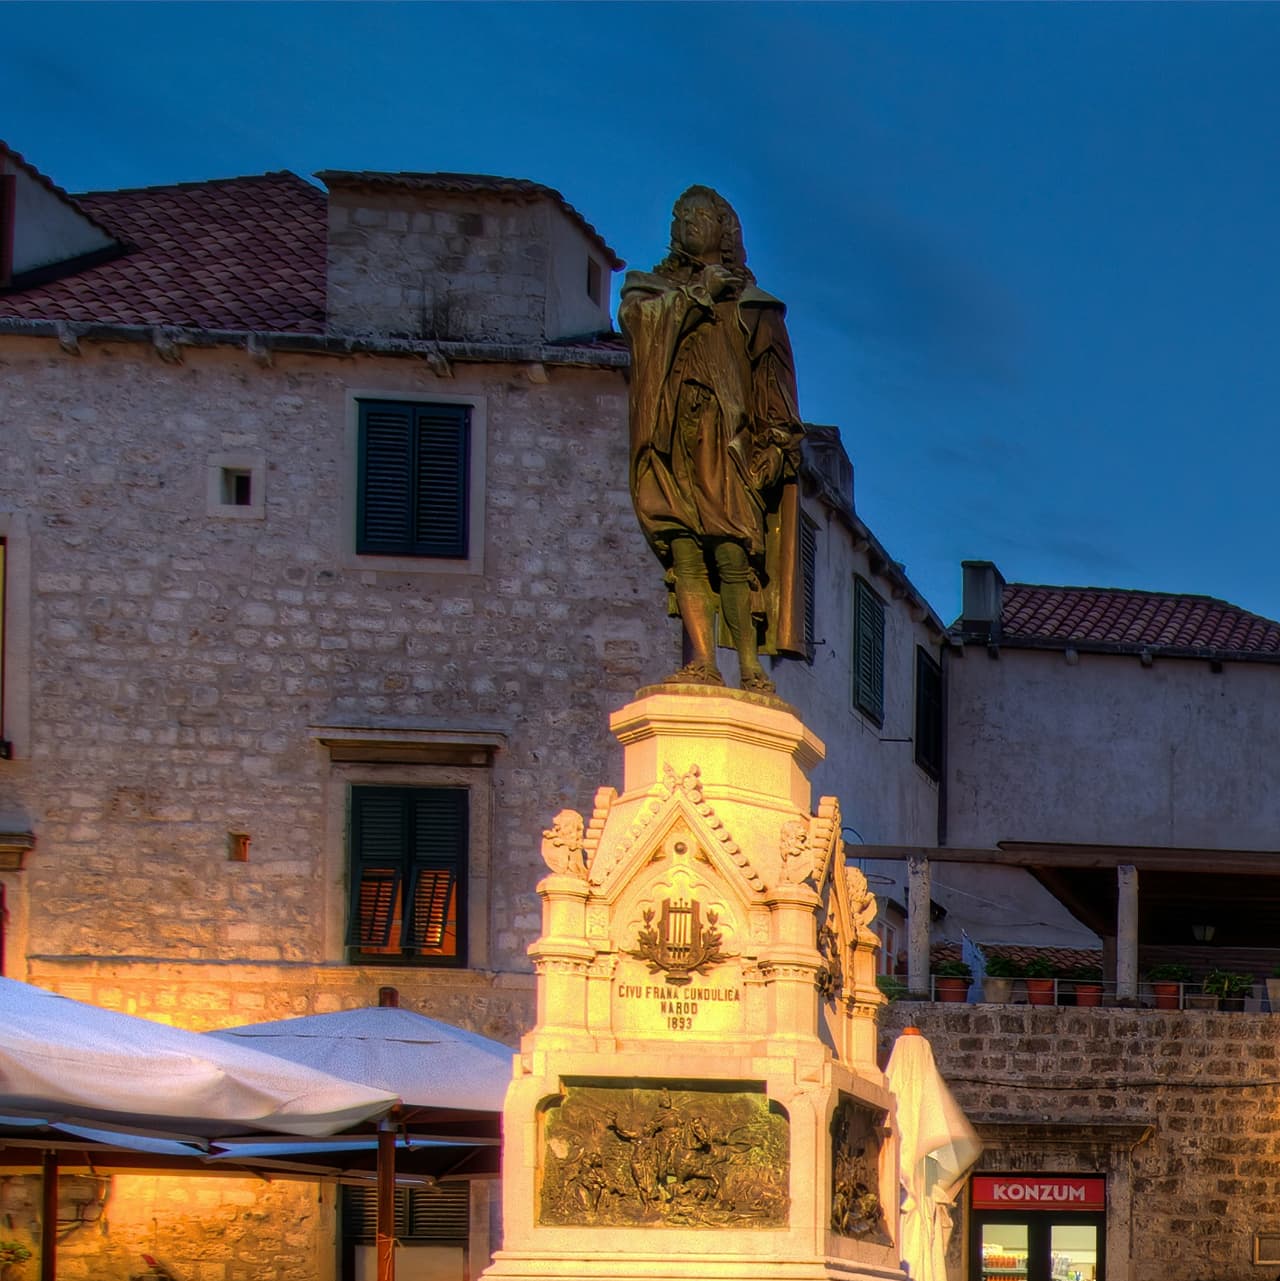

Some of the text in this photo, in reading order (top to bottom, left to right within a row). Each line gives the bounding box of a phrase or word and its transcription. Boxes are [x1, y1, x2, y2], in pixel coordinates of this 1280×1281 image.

[661, 1001, 698, 1014] NAROD
[667, 1017, 692, 1029] 1893
[993, 1183, 1085, 1201] KONZUM
